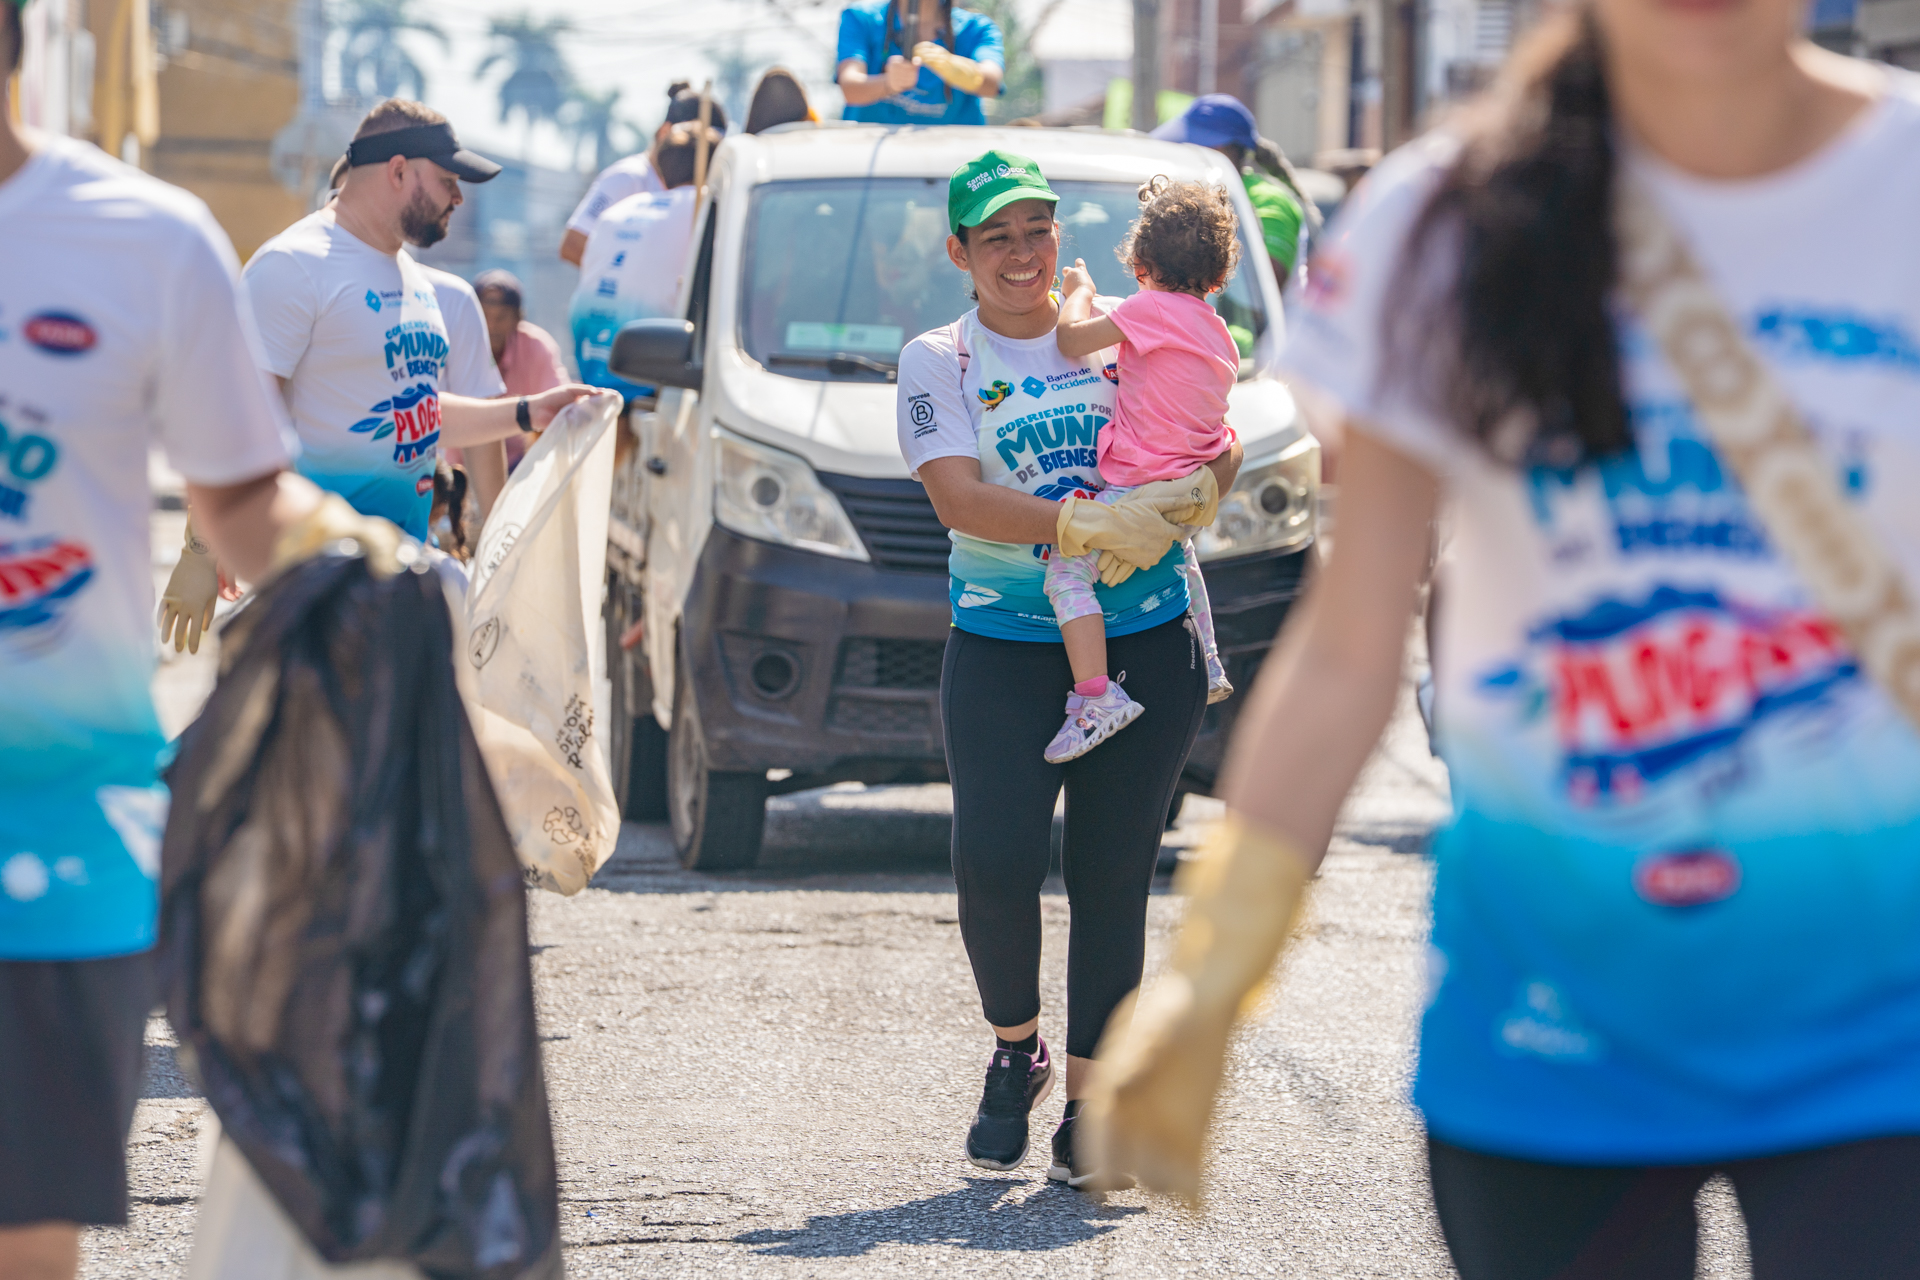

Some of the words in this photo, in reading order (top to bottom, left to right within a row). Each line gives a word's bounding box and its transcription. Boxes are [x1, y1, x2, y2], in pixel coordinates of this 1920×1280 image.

[390, 366, 406, 382] DE
[1046, 371, 1078, 383] Banco
[1078, 366, 1092, 376] de
[1051, 375, 1102, 392] Occidente
[916, 405, 929, 421] B
[996, 403, 1086, 439] CORRIENDO
[1090, 403, 1113, 417] POR
[1015, 463, 1039, 485] DE
